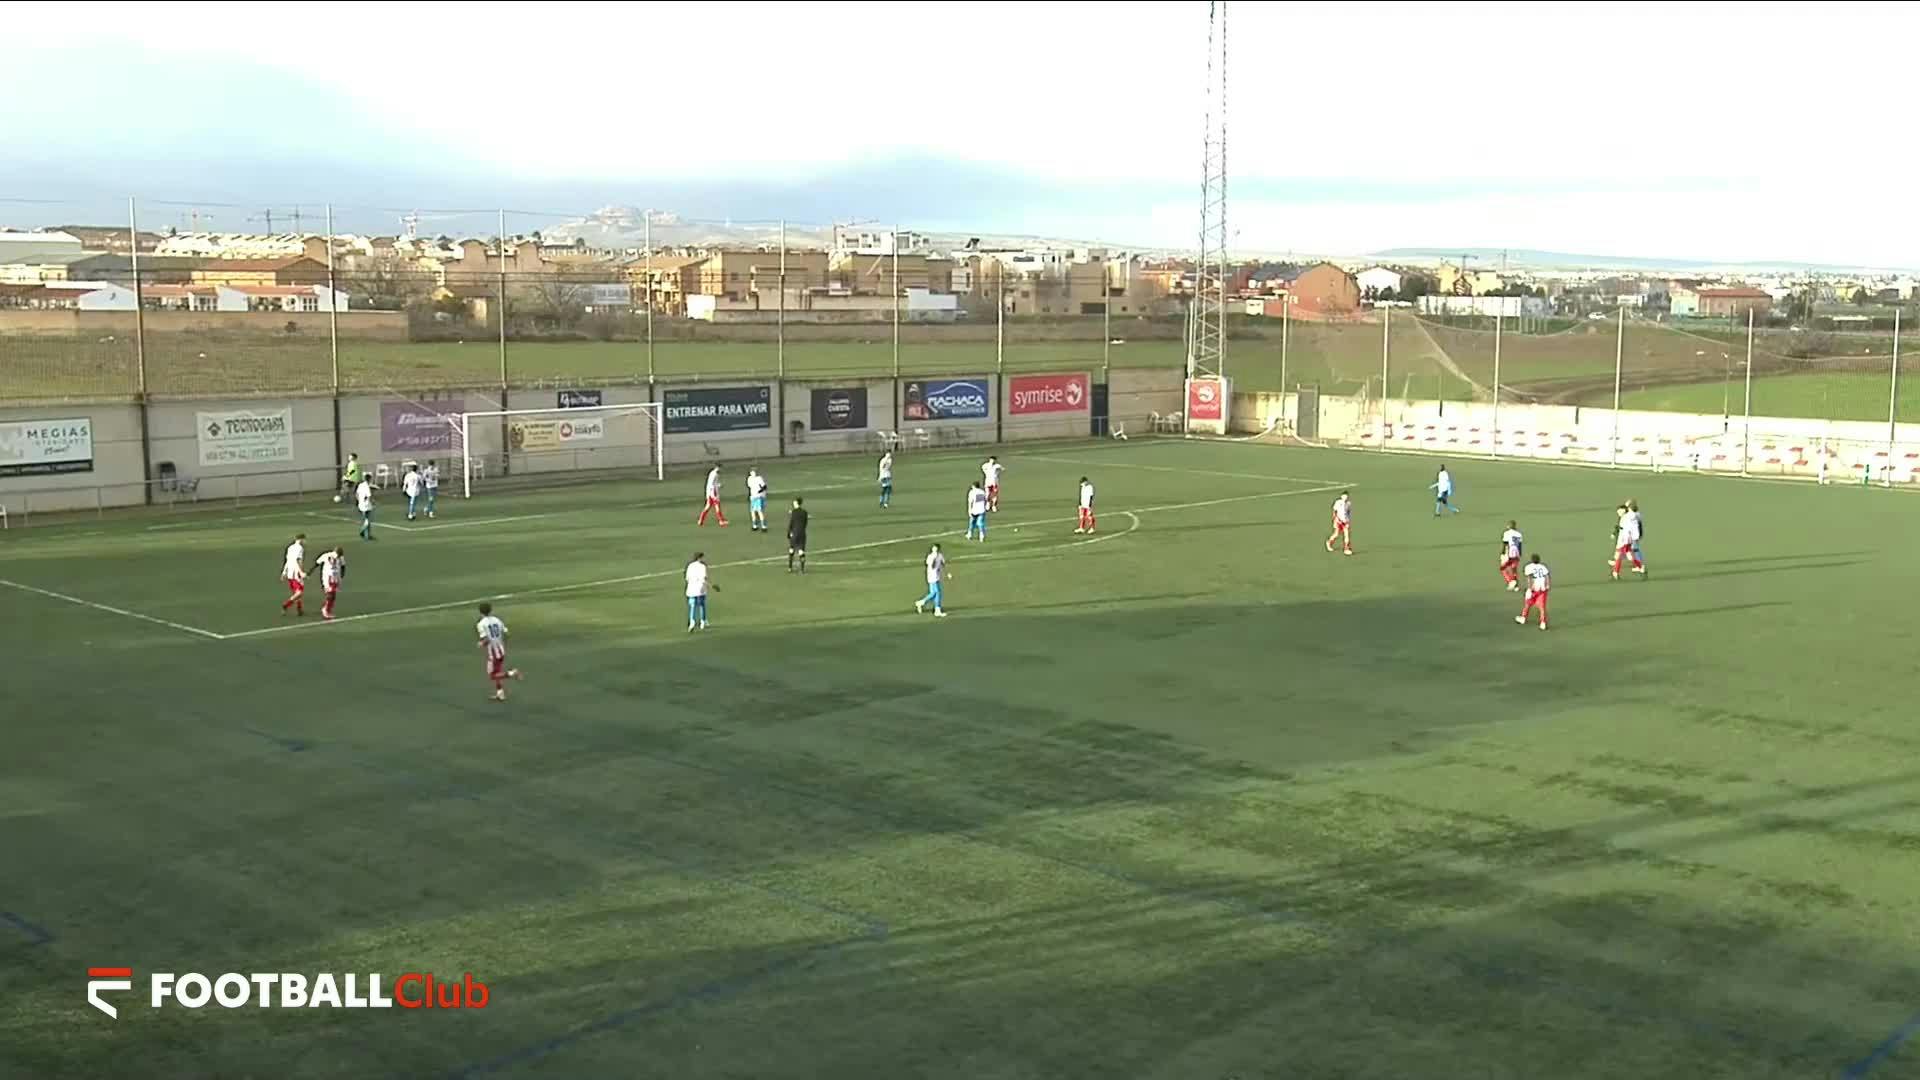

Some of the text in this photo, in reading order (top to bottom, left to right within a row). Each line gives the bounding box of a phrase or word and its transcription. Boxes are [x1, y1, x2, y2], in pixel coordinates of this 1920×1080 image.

[1014, 385, 1063, 408] symrise
[666, 402, 767, 418] ENTRENAR PARA VIVIR
[27, 426, 88, 439] MEGIAS
